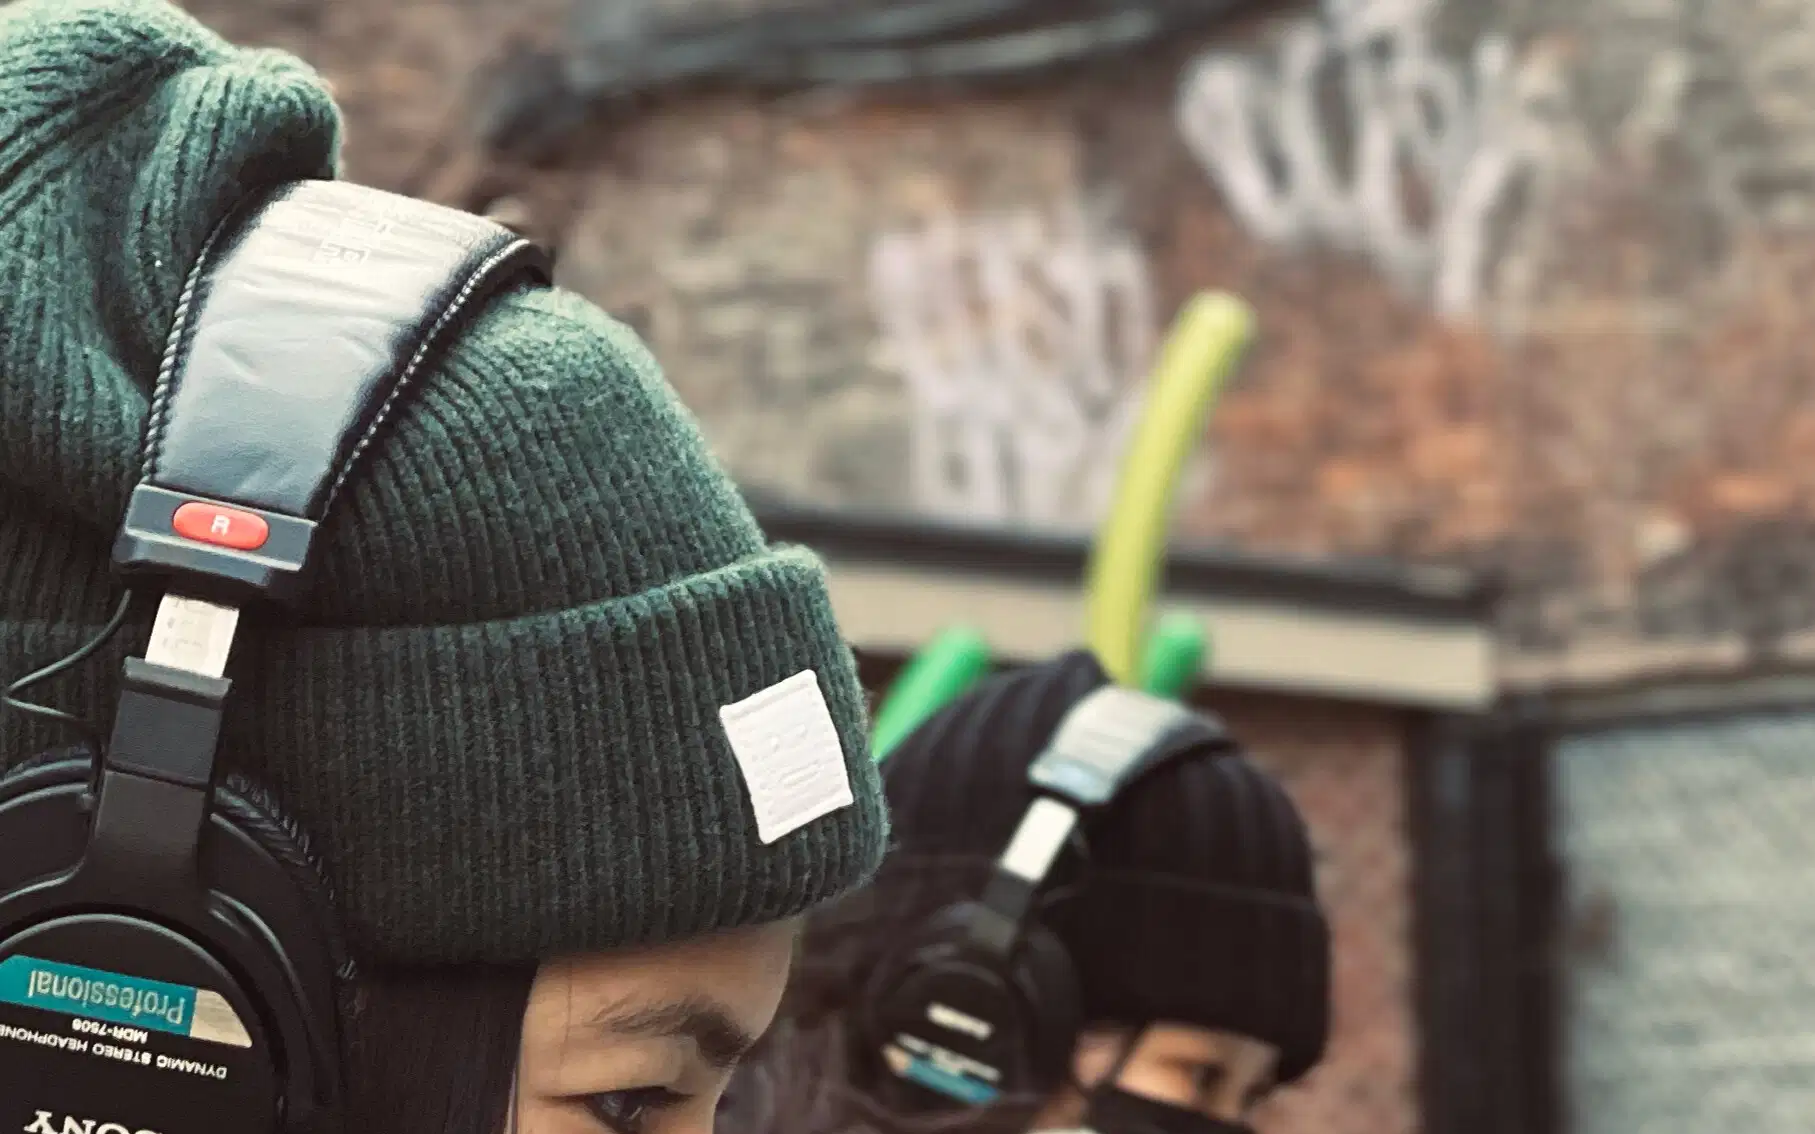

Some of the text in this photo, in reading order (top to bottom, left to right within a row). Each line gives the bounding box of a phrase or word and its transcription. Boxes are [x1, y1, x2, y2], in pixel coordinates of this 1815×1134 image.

[210, 513, 231, 537] R
[27, 969, 186, 1026] Professional
[92, 1043, 152, 1066] STEREO
[156, 1054, 228, 1080] DYNAMIC
